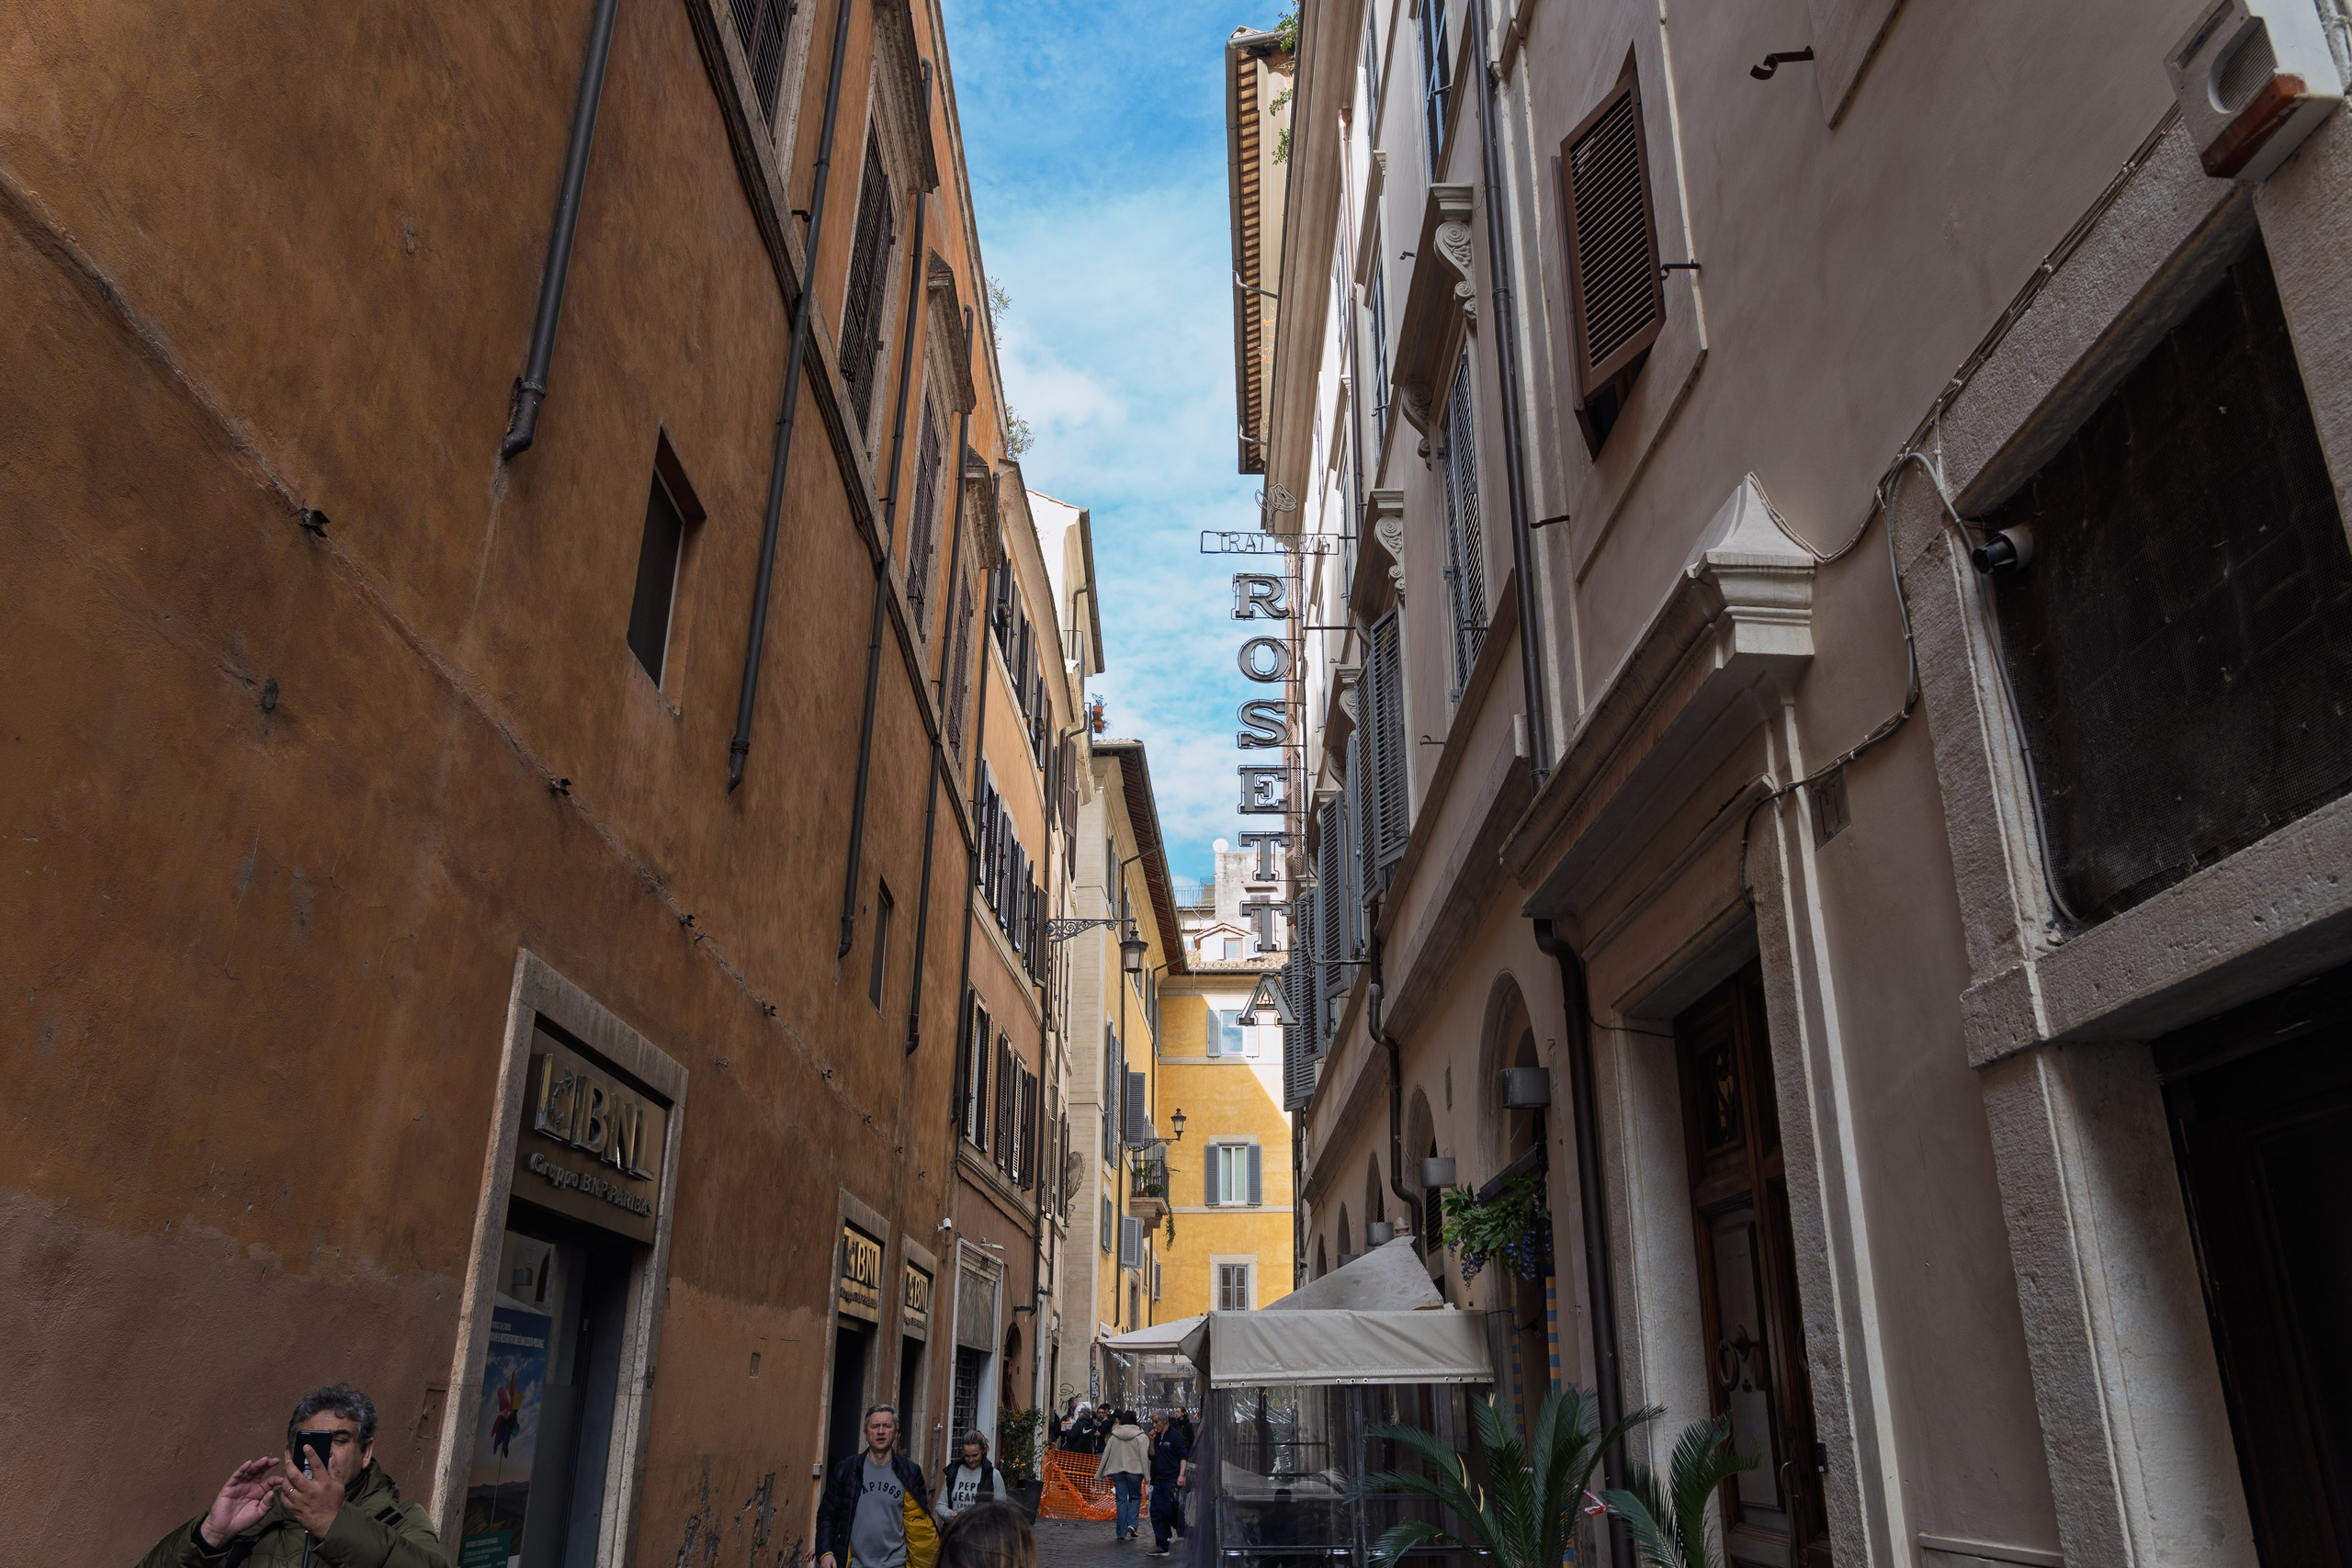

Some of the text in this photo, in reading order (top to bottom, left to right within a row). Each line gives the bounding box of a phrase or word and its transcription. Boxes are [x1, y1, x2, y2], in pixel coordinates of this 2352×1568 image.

[1230, 572, 1302, 1027] ROSETTA
[571, 1074, 655, 1182] BNL
[529, 1151, 653, 1218] Gruppo BNP PARIBAS
[856, 1240, 879, 1290] BNL
[914, 1275, 928, 1314] BNL
[862, 1481, 901, 1499] AP 1969
[952, 1491, 977, 1503] JEAN
[958, 1481, 978, 1492] PEP
